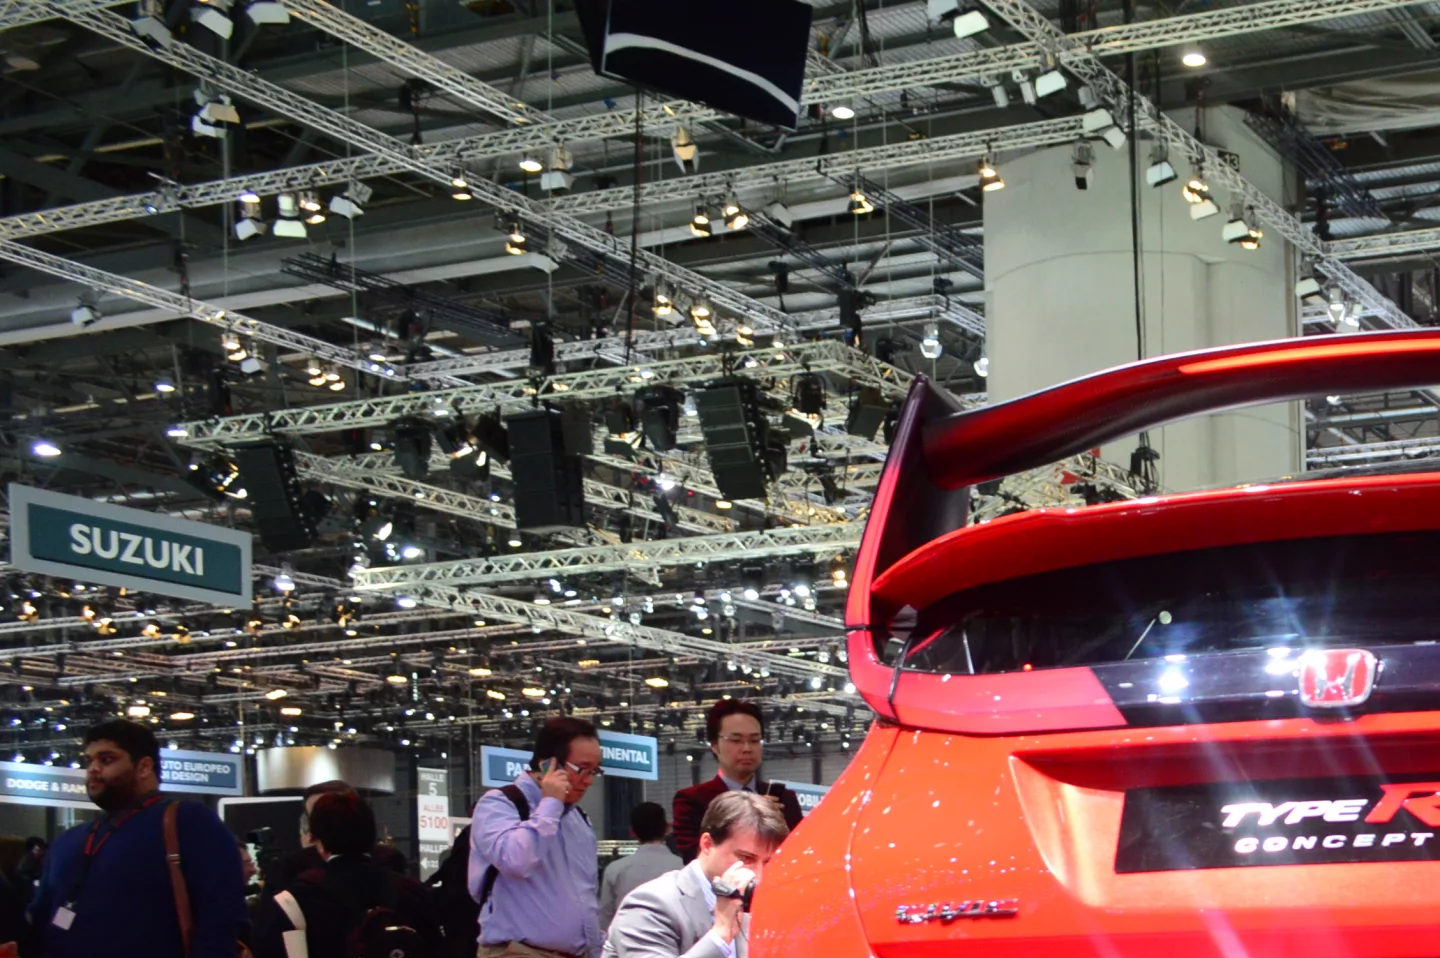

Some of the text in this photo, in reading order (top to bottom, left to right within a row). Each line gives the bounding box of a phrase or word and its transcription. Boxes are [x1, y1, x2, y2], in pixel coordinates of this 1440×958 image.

[70, 523, 204, 576] SUZUKI
[183, 761, 231, 774] EUROPEO
[171, 771, 209, 783] DESIGN
[6, 777, 87, 794] DODGE & RAM
[428, 782, 438, 797] 5
[1221, 799, 1369, 828] TYPE
[420, 815, 448, 829] 5100
[1234, 832, 1434, 854] CONCEPT
